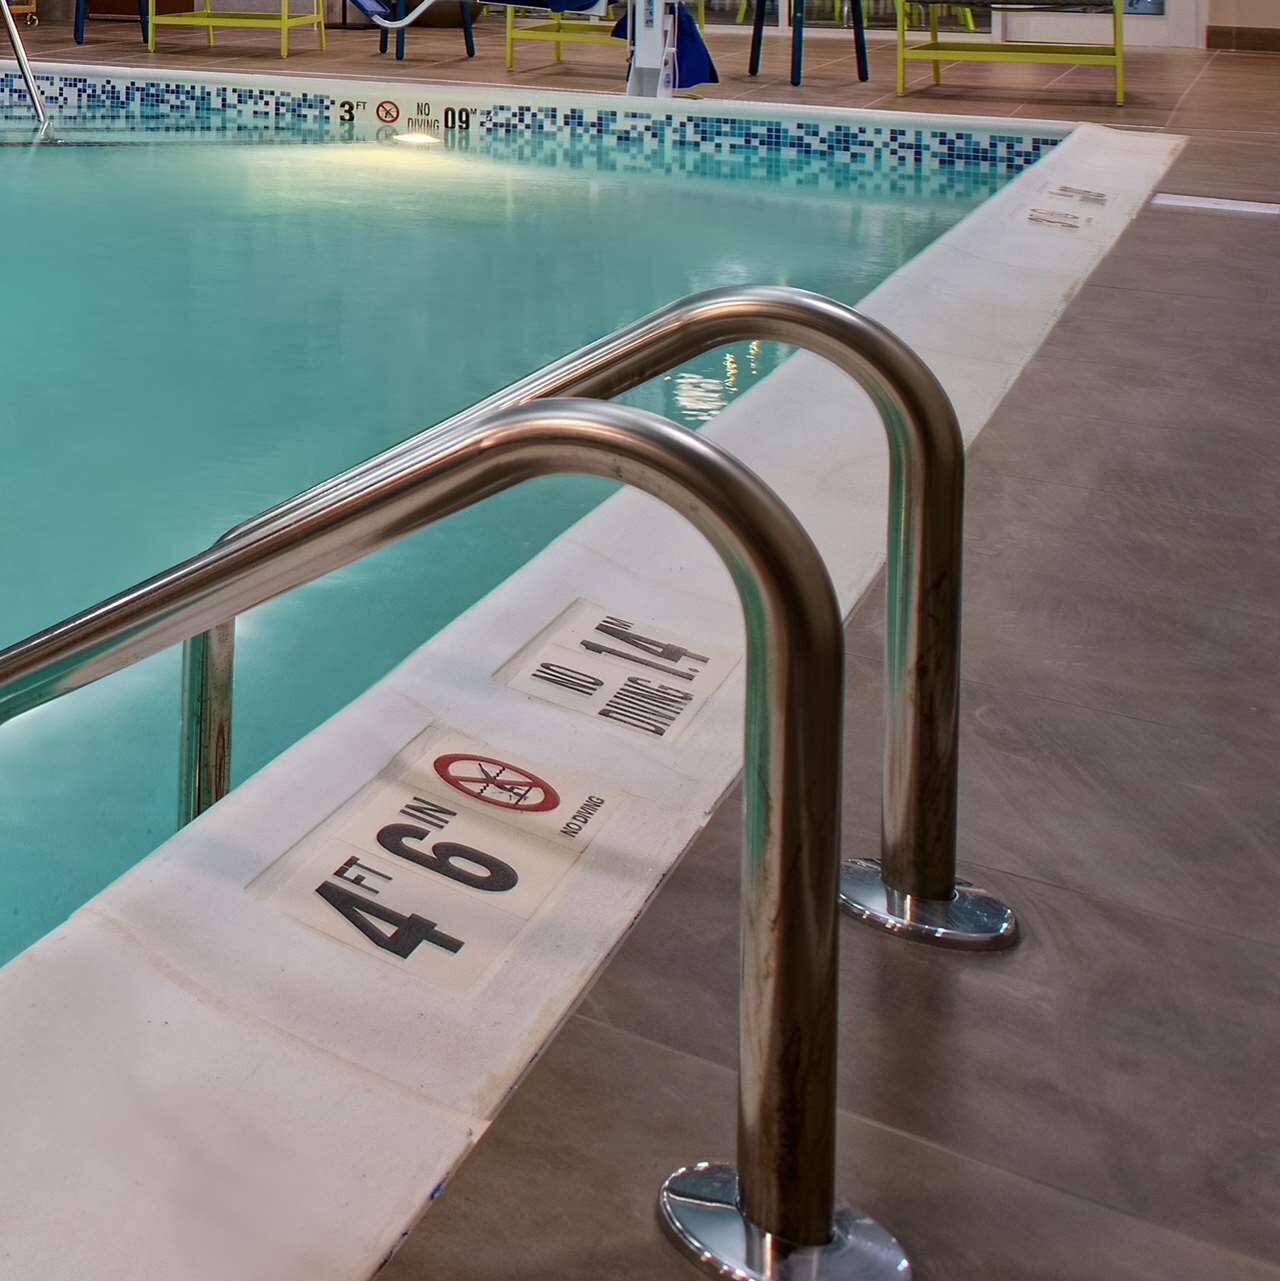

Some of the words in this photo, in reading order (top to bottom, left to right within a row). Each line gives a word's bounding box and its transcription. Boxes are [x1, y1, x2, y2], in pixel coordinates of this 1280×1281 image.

[407, 117, 440, 131] DIVING
[416, 102, 431, 117] NO
[531, 662, 604, 696] NO
[598, 676, 695, 736] DIVING
[560, 820, 580, 838] NO
[578, 794, 605, 825] DIVING
